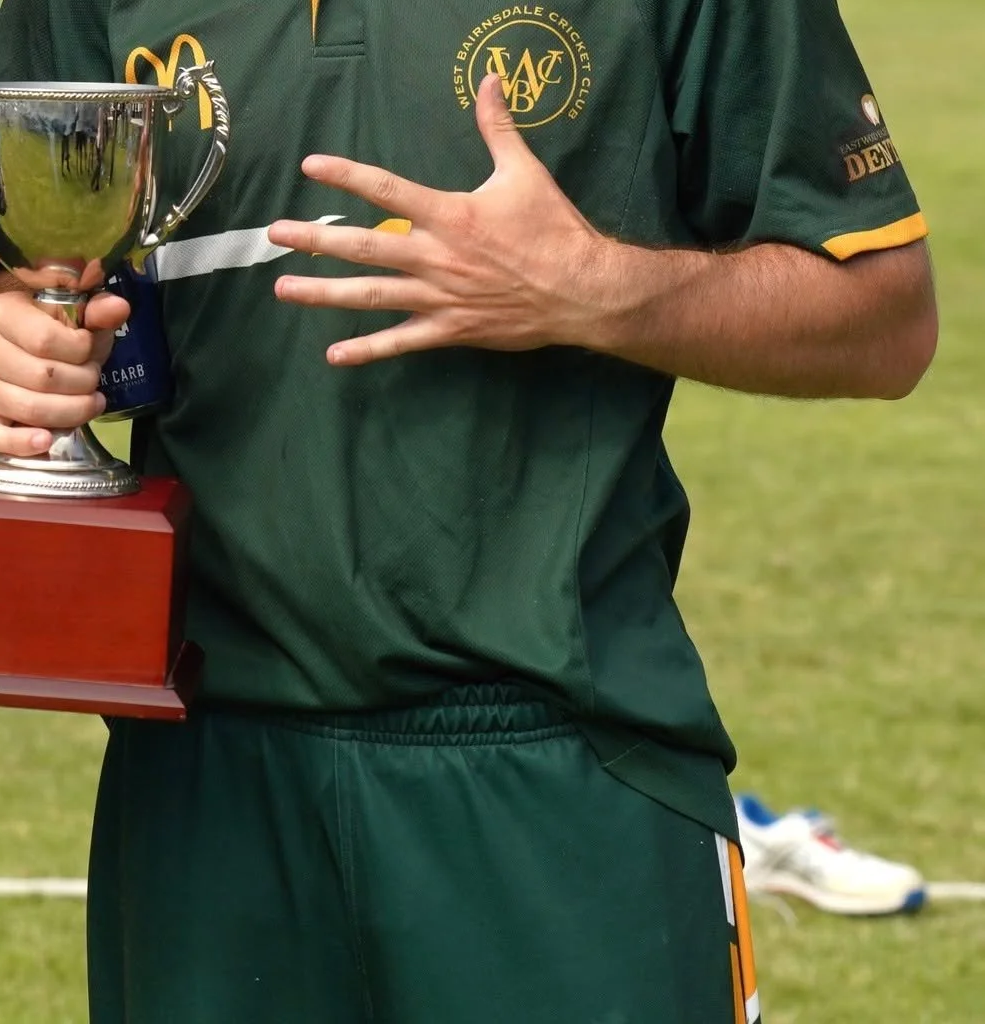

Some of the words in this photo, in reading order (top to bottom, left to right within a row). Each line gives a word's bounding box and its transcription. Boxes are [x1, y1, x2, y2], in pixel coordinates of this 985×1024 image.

[456, 5, 544, 61] BAIRNSDALE
[548, 11, 592, 72] CRICKET
[453, 65, 471, 110] WEST
[567, 77, 591, 120] CLUB
[111, 364, 145, 384] CARB
